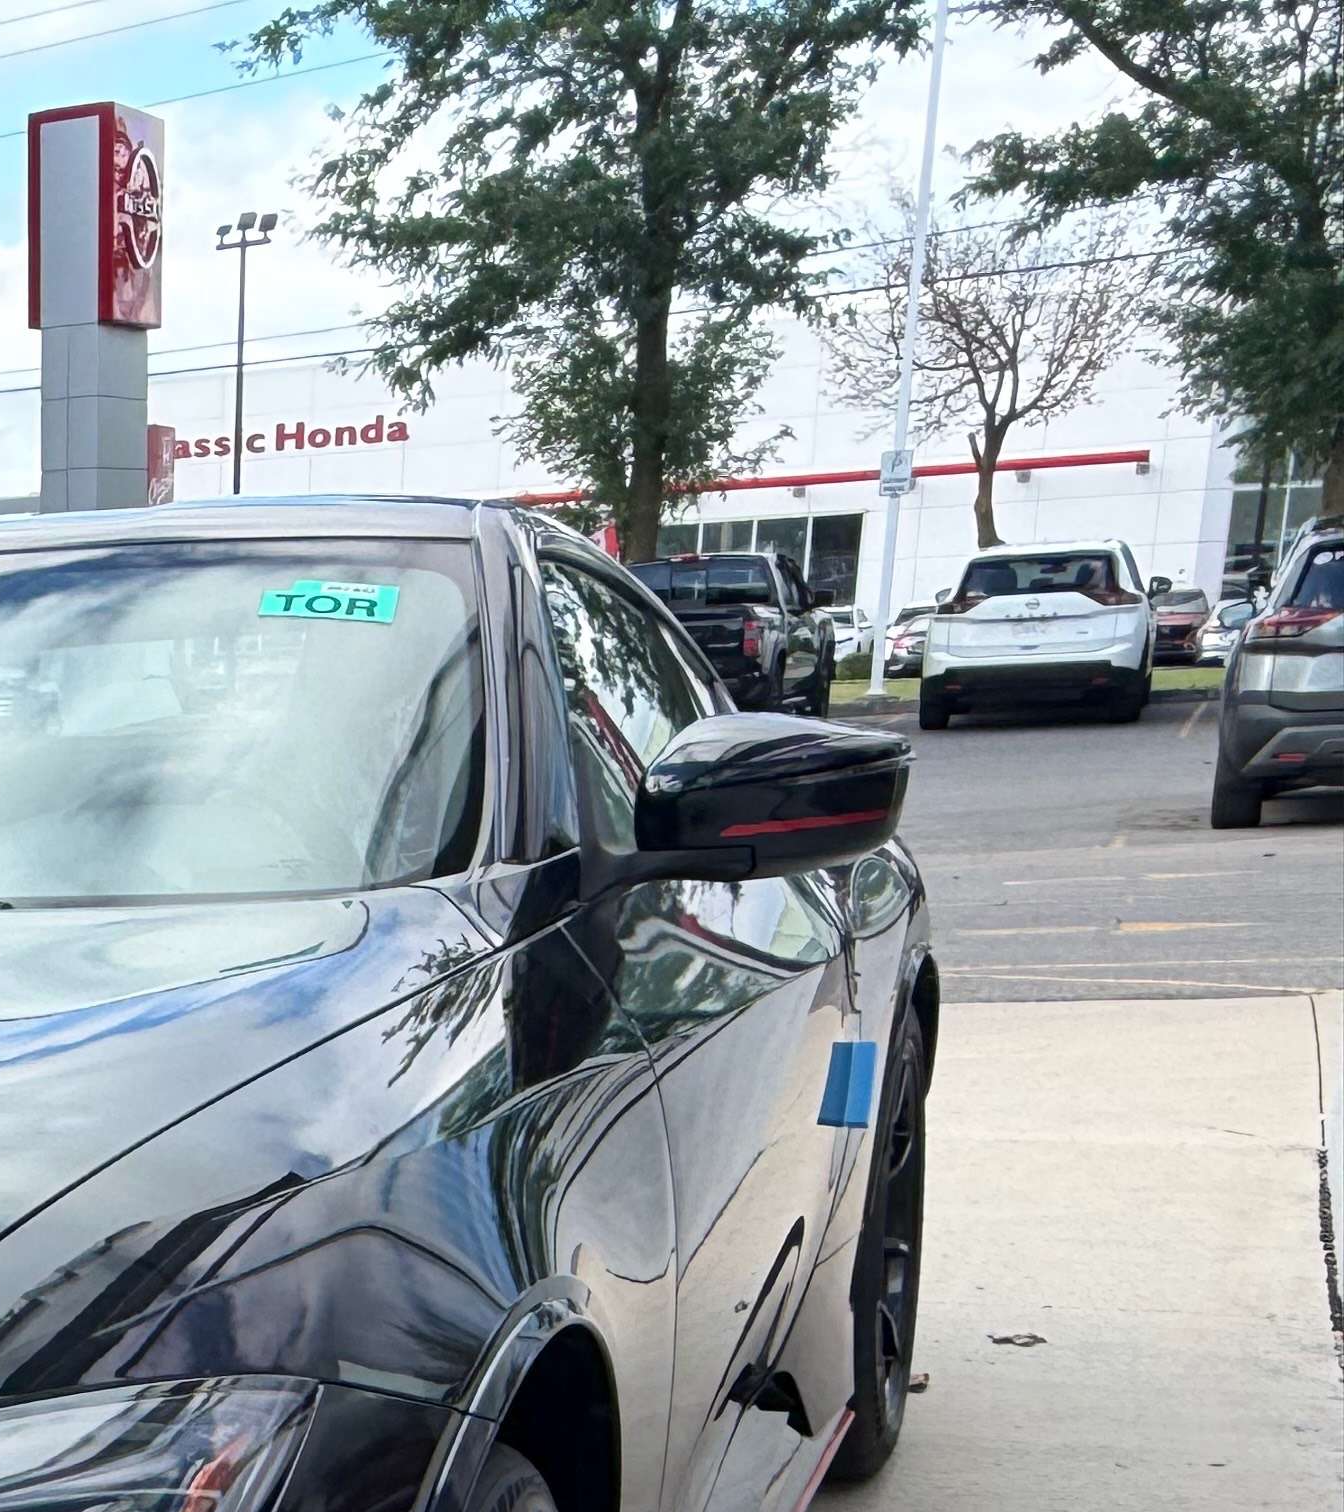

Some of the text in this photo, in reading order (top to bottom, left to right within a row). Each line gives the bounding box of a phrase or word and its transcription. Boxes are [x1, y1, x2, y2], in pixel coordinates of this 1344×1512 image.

[173, 415, 410, 459] assc Honda
[276, 594, 379, 617] TOR
